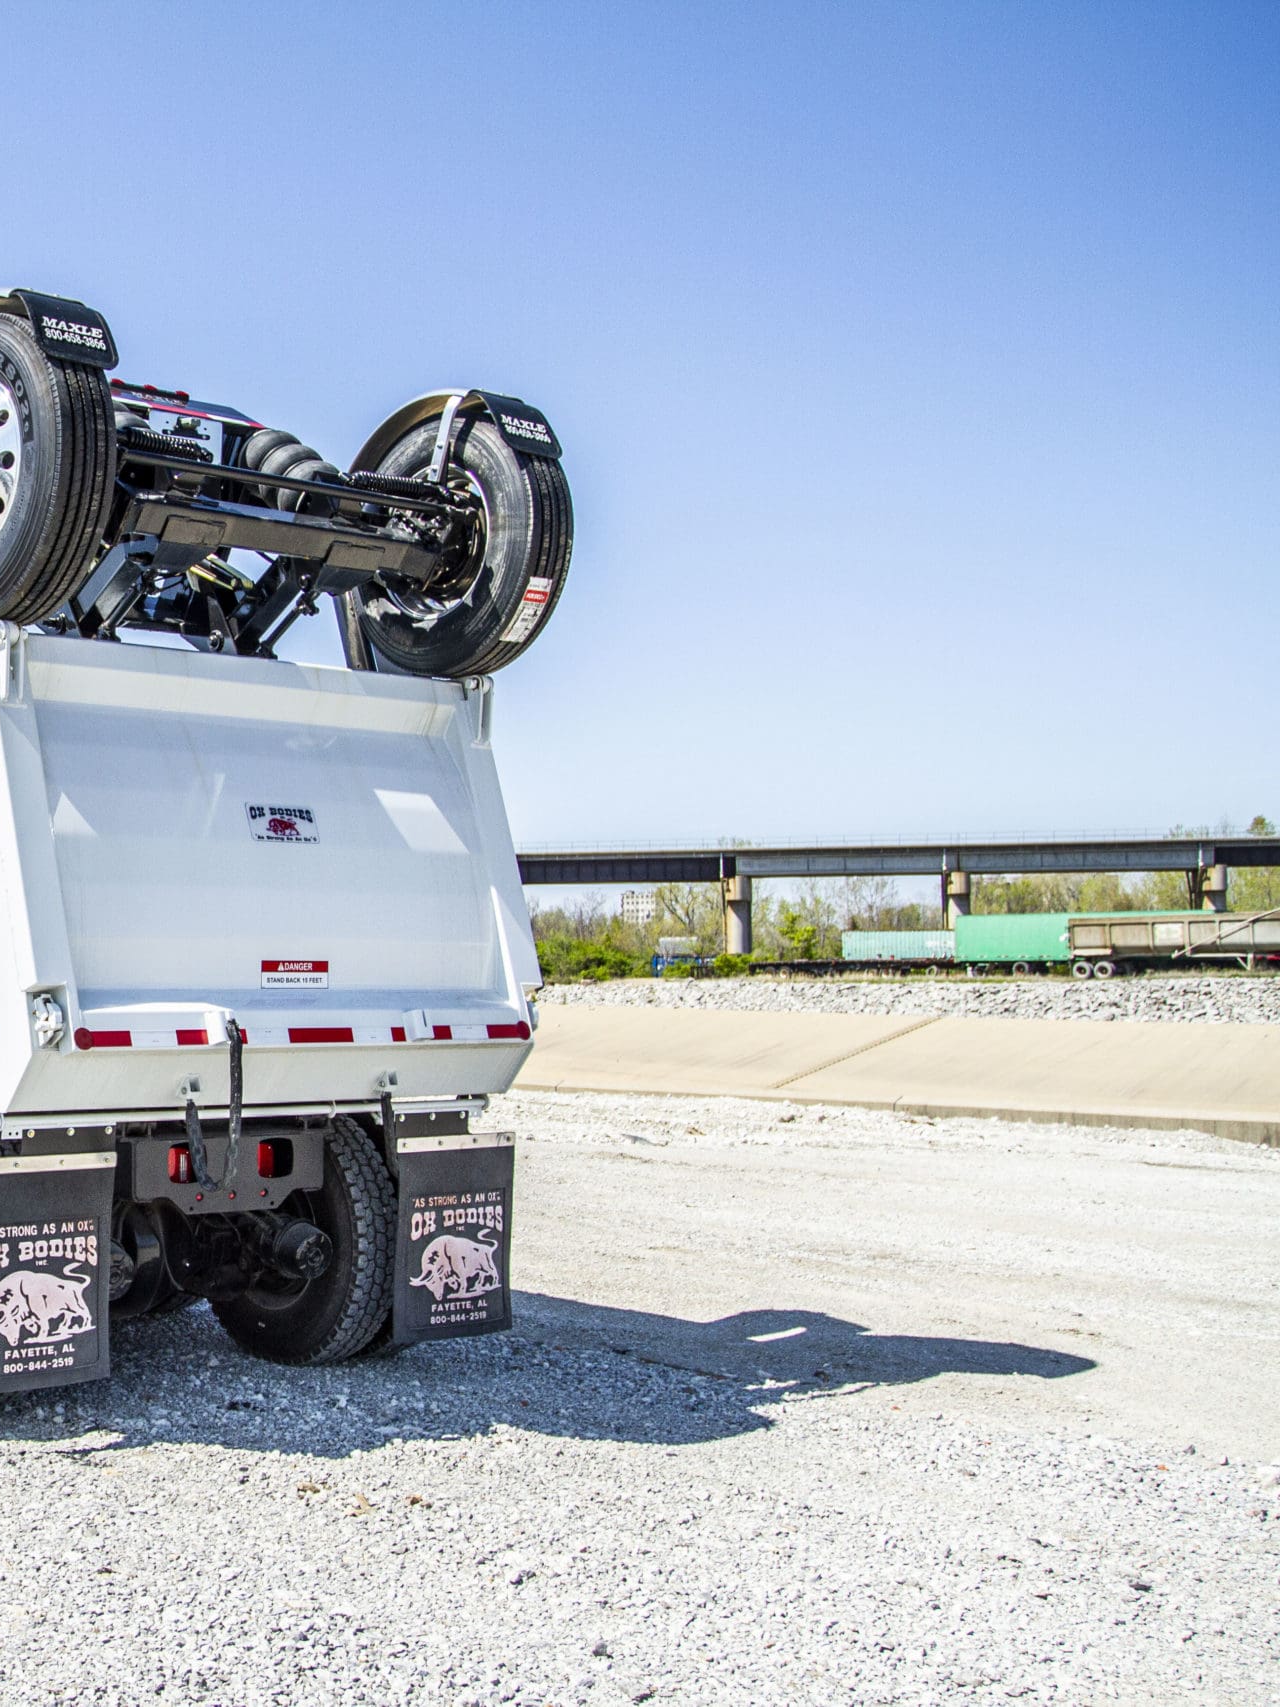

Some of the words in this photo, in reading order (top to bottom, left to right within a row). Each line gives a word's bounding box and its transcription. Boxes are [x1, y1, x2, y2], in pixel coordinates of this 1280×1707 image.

[41, 316, 103, 338] MAXLE
[500, 414, 546, 433] MAXLE
[249, 806, 266, 820] OX
[268, 807, 314, 823] BODIES
[284, 962, 313, 971] DANGER
[428, 1194, 458, 1208] STRONG
[461, 1193, 472, 1204] AS
[475, 1192, 486, 1203] AN
[0, 1225, 38, 1239] STRONG
[42, 1223, 56, 1235] AS
[61, 1221, 74, 1233] AN
[410, 1210, 437, 1241] OX
[442, 1204, 504, 1233] BODIES
[18, 1235, 98, 1267] BODIES
[431, 1300, 474, 1313] FAYETTE,
[477, 1299, 488, 1308] AL
[430, 1310, 487, 1325] 800-844-2519
[4, 1345, 58, 1360] FAYETTE,
[62, 1343, 76, 1353] AL
[3, 1356, 74, 1374] 800-844-2519
